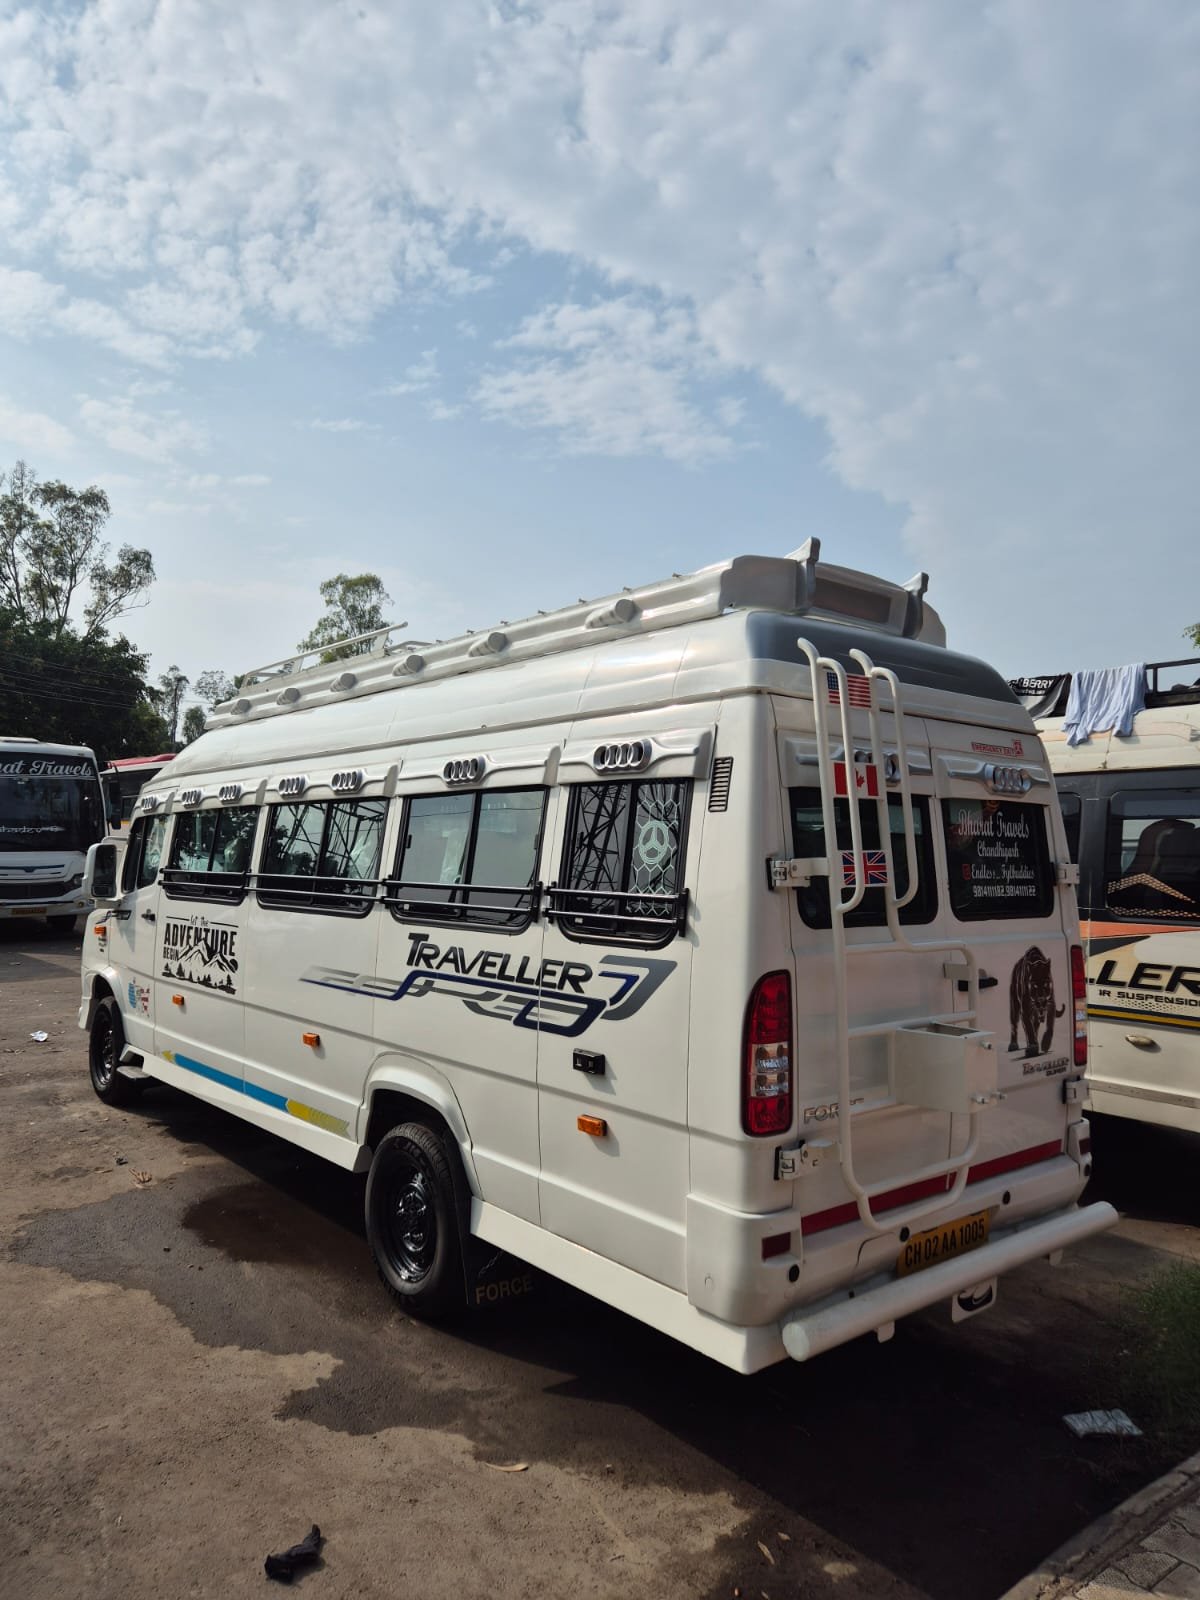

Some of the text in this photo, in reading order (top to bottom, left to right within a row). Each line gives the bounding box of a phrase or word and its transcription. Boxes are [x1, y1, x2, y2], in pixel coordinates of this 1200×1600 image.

[29, 760, 92, 776] Travels
[958, 808, 1030, 839] Bharat Travels
[164, 923, 237, 956] ADVENTURE
[406, 932, 593, 994] TRAVELLER
[1117, 991, 1200, 1007] SUSPENSIO
[905, 1218, 985, 1267] CH 02 AA 1005
[475, 1275, 535, 1305] FORCE
